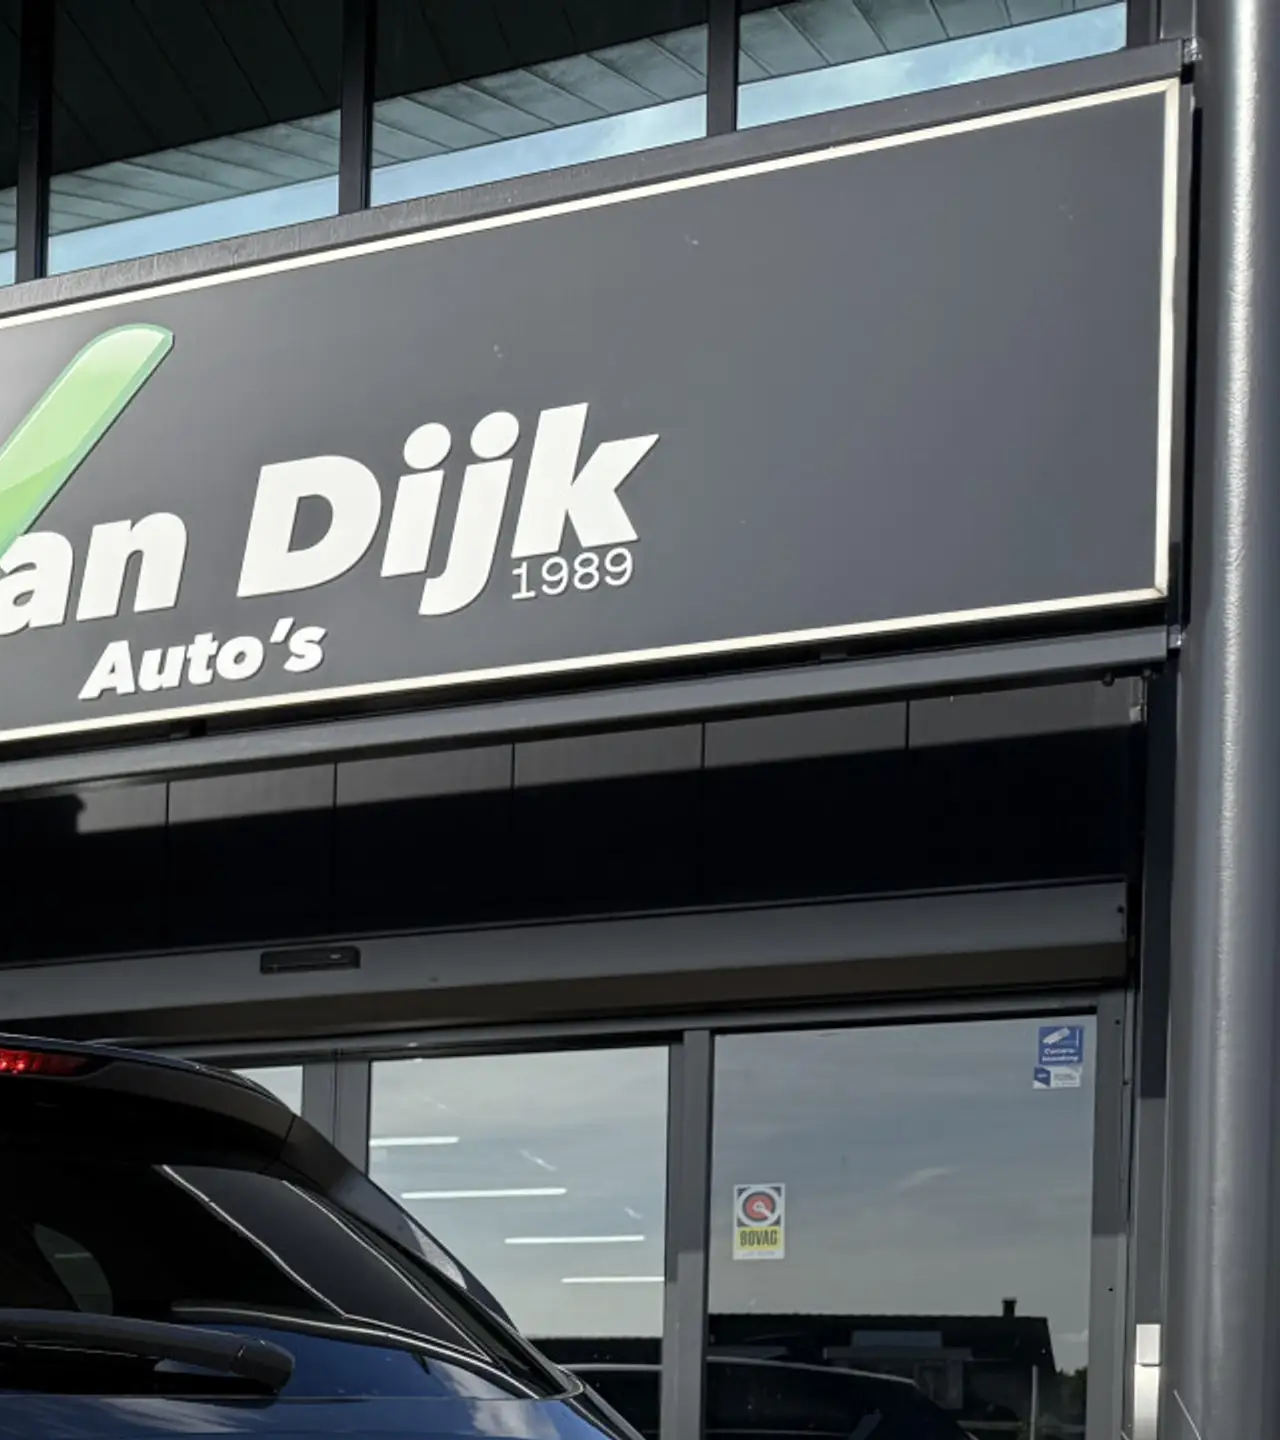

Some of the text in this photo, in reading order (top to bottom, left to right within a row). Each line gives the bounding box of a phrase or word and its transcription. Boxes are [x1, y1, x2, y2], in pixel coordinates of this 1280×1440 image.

[237, 402, 660, 616] Dijk
[510, 548, 633, 600] 1989
[77, 616, 327, 700] Auto's
[739, 1230, 778, 1247] BOVAG
